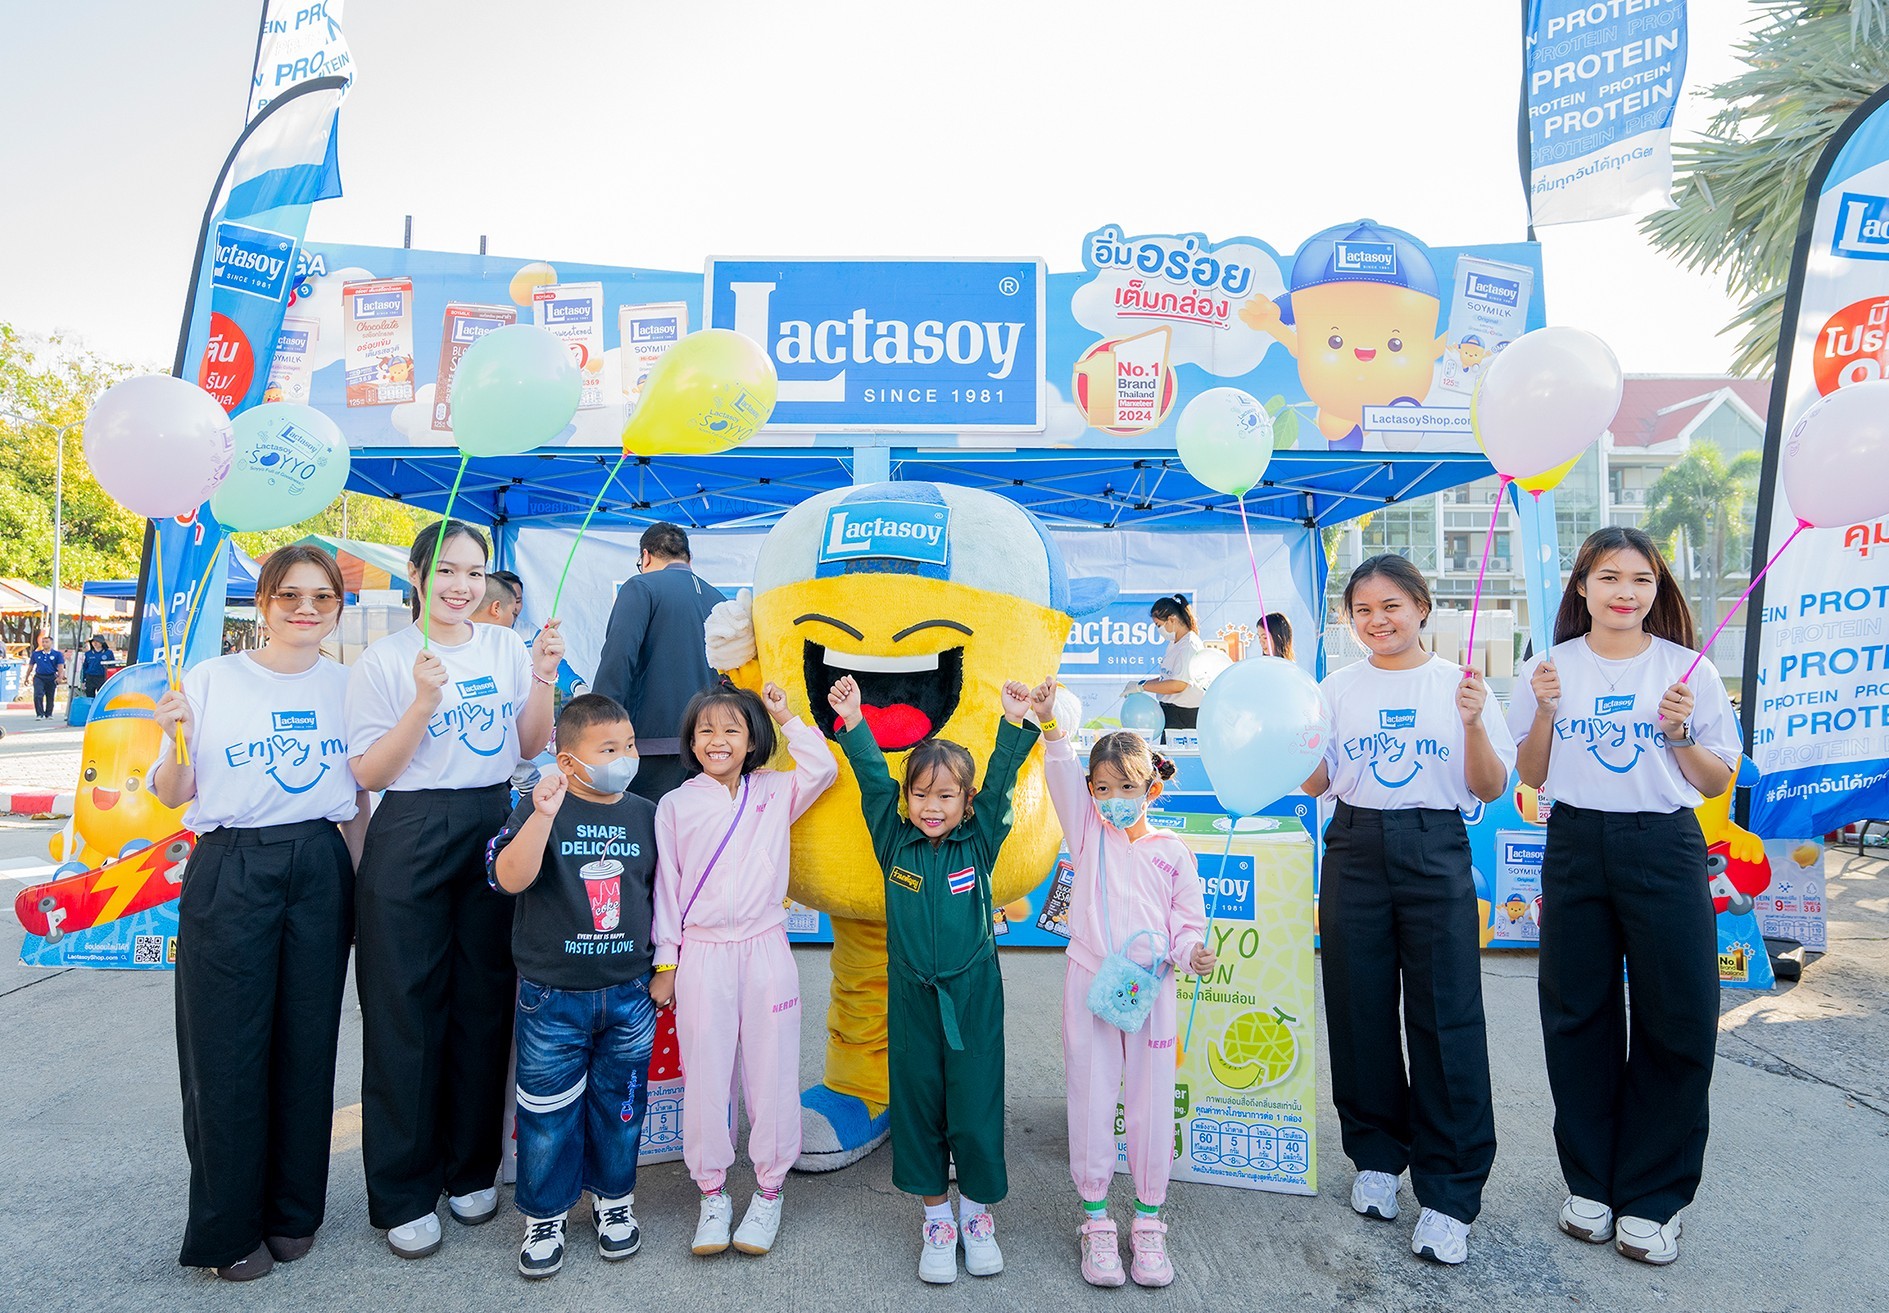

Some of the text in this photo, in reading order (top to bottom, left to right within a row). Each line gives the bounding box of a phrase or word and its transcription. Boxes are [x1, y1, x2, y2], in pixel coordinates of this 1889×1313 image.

[1532, 28, 1679, 96] PROTEIN
[1599, 61, 1671, 98] PROTEIN
[1544, 77, 1673, 139] PROTEIN
[1338, 245, 1393, 269] Lactasoy
[226, 272, 272, 289] SINCE 1981
[1468, 275, 1517, 300] Lactasoy
[356, 297, 401, 317] Lactasoy
[1114, 279, 1229, 318] เต็มกล่อง
[546, 303, 591, 322] Lactasoy
[1467, 302, 1512, 318] SOYMILK
[356, 319, 399, 332] Chocolate
[546, 325, 593, 337] sweetened
[632, 322, 676, 341] Lactasoy
[730, 282, 1026, 402] Lactasoy
[1825, 325, 1889, 358] โปร
[1118, 362, 1159, 377] No.1
[1118, 379, 1156, 389] Brand
[1442, 377, 1455, 387] 125
[864, 388, 1004, 403] SINCE 1981
[1118, 411, 1152, 421] 2024
[281, 425, 318, 453] Lactasoy
[255, 443, 293, 455] Lactasoy
[826, 511, 943, 555] Lactasoy
[1062, 617, 1164, 662] actas
[1776, 617, 1882, 648] PROTEIN
[460, 681, 496, 697] Lactasoy
[1597, 696, 1633, 713] Lactasoy
[275, 713, 315, 730] Lactasoy
[1381, 711, 1415, 728] Lactasoy
[1554, 717, 1665, 748] Enjoy me
[225, 734, 310, 767] Enjoy
[1343, 732, 1450, 763] Enjoy me
[576, 825, 627, 839] SHARE
[561, 841, 641, 857] DELICIOUS
[1222, 904, 1243, 912] 1981
[1774, 899, 1784, 912] 9
[610, 932, 625, 940] HAPPY
[564, 940, 635, 955] TASTE OF LOVE
[67, 953, 118, 961] LactasoyShop.com
[1197, 987, 1256, 1005] กลิ่นเมล่อน
[772, 997, 799, 1013] NERDY
[660, 1114, 668, 1124] 5
[1195, 1106, 1274, 1120] คุณค่าทางโภชนาการต่อ
[1283, 1113, 1302, 1123] กล่อง
[1199, 1133, 1213, 1144] 60
[1231, 1136, 1238, 1147] 5
[1256, 1139, 1272, 1150] 1.5
[1285, 1142, 1300, 1153] 40
